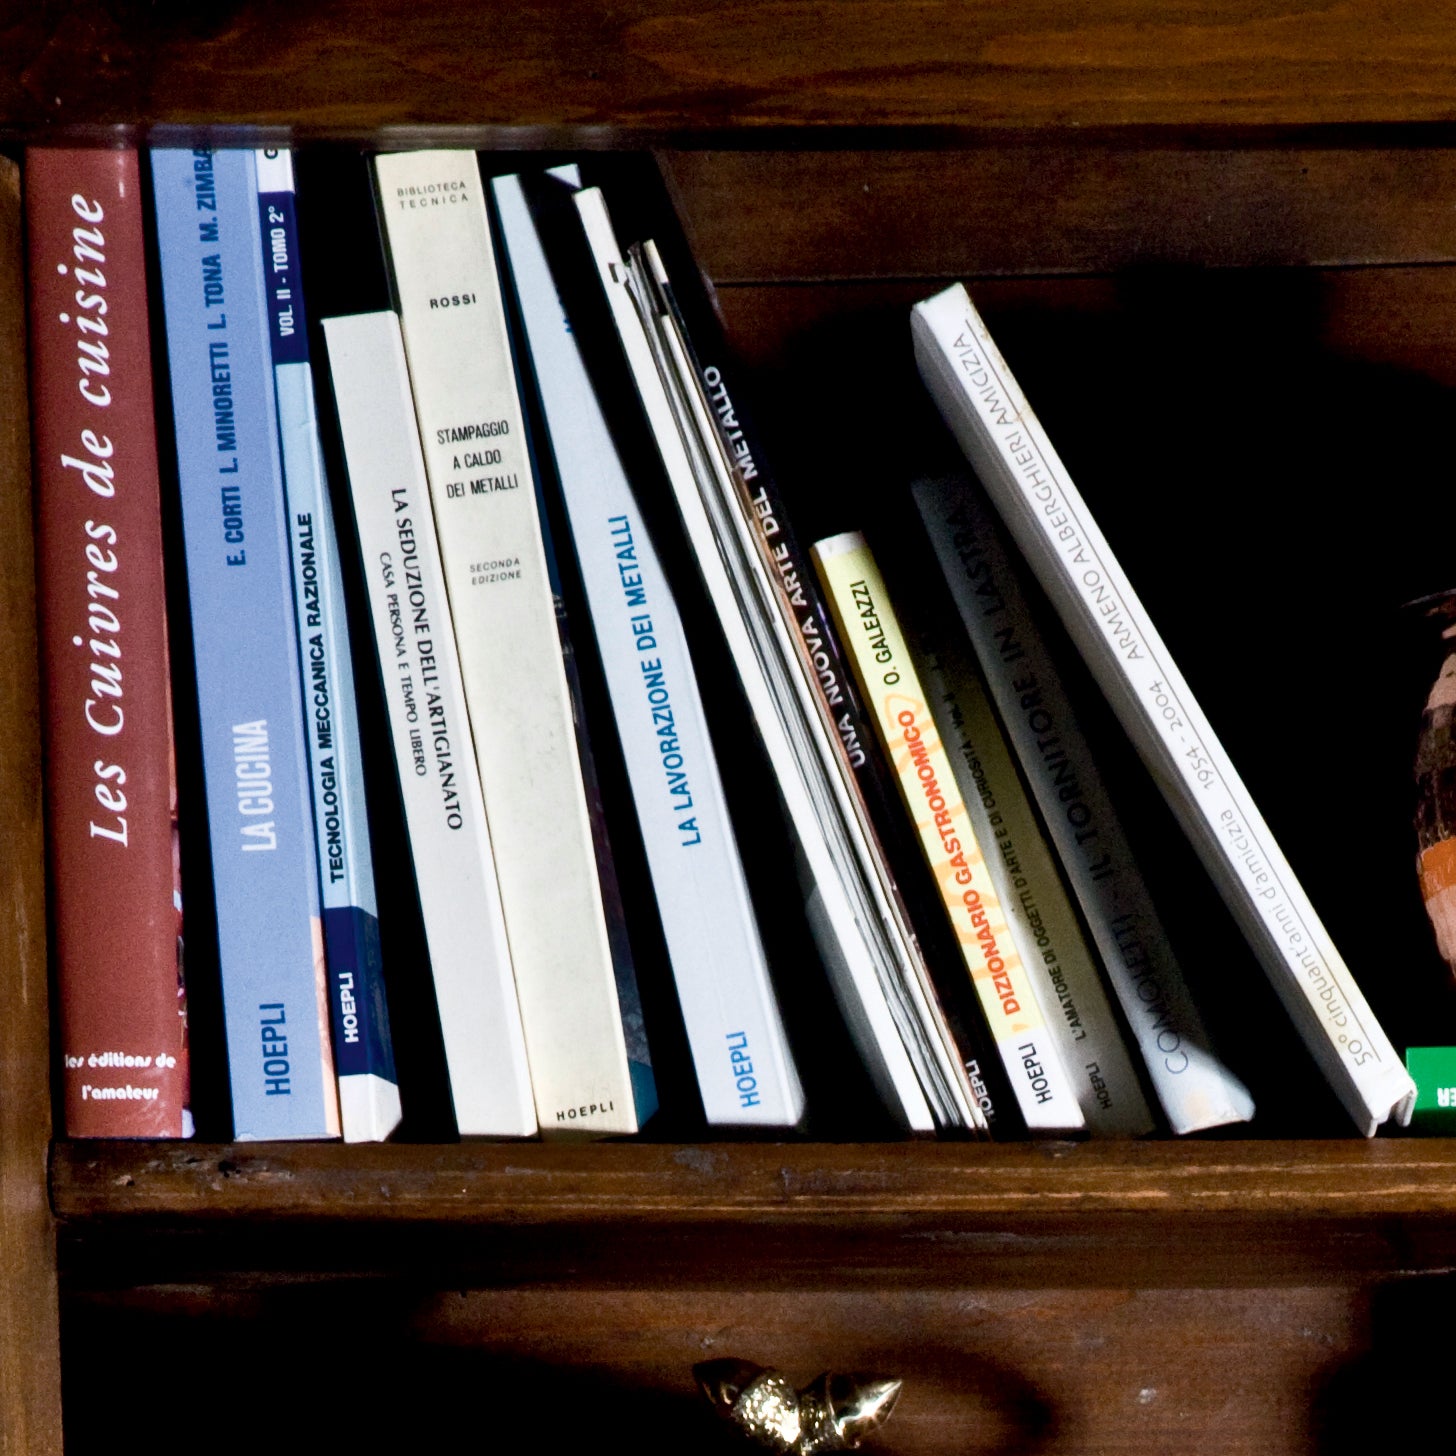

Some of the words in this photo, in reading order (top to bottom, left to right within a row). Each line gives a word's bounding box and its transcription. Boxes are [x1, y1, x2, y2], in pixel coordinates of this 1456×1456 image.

[268, 205, 284, 223] 2°
[397, 181, 466, 197] BIBLIOTECA
[400, 193, 469, 209] TECNICA
[199, 216, 218, 241] M.
[271, 228, 288, 272] TOMO
[57, 193, 112, 407] cuisine
[204, 253, 224, 308] TONA
[277, 289, 291, 300] II
[430, 294, 477, 309] ROSSI
[208, 314, 226, 330] L.
[210, 342, 236, 451] MINORETTI
[952, 332, 1013, 424] AMICIZIA
[437, 420, 509, 445] STAMPAGGIO
[704, 366, 758, 480] METALLO
[61, 429, 115, 497] de
[218, 456, 237, 473] L.
[446, 482, 465, 499] DEI
[470, 473, 519, 495] METALLI
[452, 455, 461, 470] A
[464, 449, 502, 467] CALDO
[221, 486, 243, 543] CORTI
[391, 488, 408, 513] LA
[753, 486, 779, 535] DEL
[1005, 431, 1090, 564] ALBERGHIERI
[227, 549, 246, 566] E.
[298, 513, 321, 627] RAZIONALE
[397, 519, 430, 634] SEDUZIONE
[470, 557, 521, 573] SECONDA
[472, 570, 521, 586] EDIZIONE
[608, 515, 648, 606] METALLI
[773, 542, 806, 608] ARTE
[73, 520, 124, 735] Cuivres
[628, 613, 657, 651] DEI
[850, 580, 893, 664] GALEAZZI
[1083, 570, 1144, 660] ARMENO
[379, 551, 395, 589] CASA
[387, 593, 406, 658] PERSONA
[399, 674, 418, 725] TEMPO
[410, 729, 427, 777] LIBERO
[801, 616, 843, 706] NUOVA
[994, 625, 1024, 662] IN
[309, 633, 333, 749] MECCANICA
[884, 666, 900, 685] O.
[1149, 679, 1183, 731] 2004
[417, 639, 463, 830] DELL'ARTIGIANATO
[641, 657, 693, 810] LAVORAZIONE
[839, 714, 865, 769] UNA
[1014, 671, 1098, 844] TORNITORE
[232, 719, 274, 816] CUCINA
[1185, 745, 1215, 791] 1954
[90, 760, 129, 847] Les
[319, 756, 344, 883] TECNOLOGIA
[898, 710, 973, 885] GASTRONOMICO
[242, 821, 277, 852] LA
[678, 818, 701, 847] LA
[1220, 809, 1276, 900] d'amicizia
[1019, 890, 1049, 946] OGGETTI
[963, 890, 1021, 1015] DIZIONARIO
[1275, 903, 1348, 1028] cinquant'anni
[339, 972, 359, 1042] HOEPLI
[65, 1054, 84, 1068] les
[88, 1052, 151, 1069] éditions
[155, 1052, 177, 1068] de
[259, 1003, 290, 1096] HOEPLI
[726, 1031, 761, 1109] HOEPLI
[1018, 1042, 1053, 1105] HOEPLI
[82, 1085, 159, 1100] l'amateur
[557, 1101, 614, 1121] HOEPLI
[1086, 1062, 1113, 1110] HOEPLI
